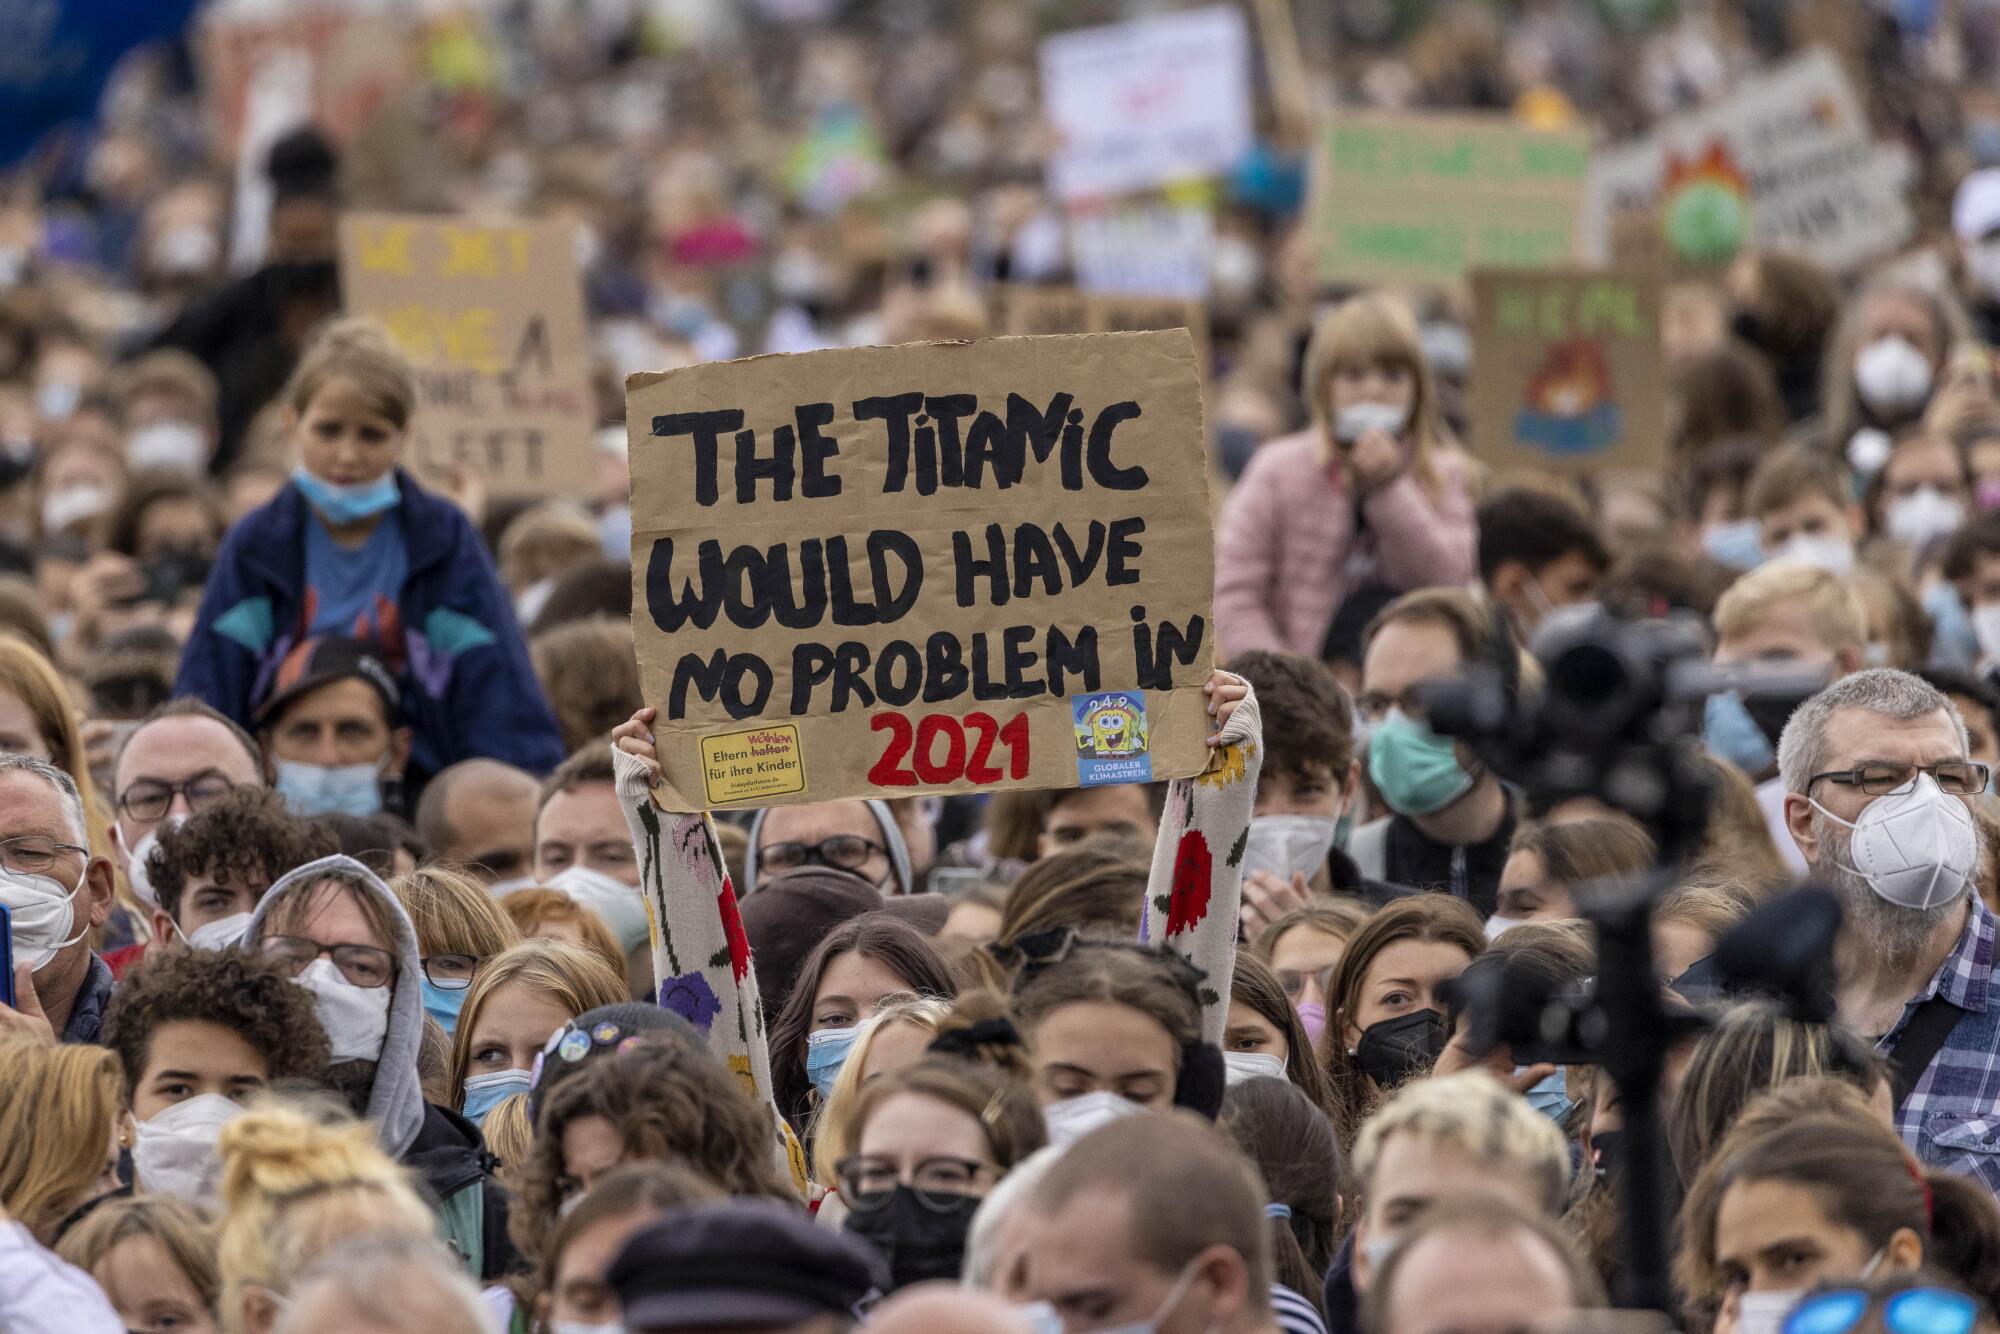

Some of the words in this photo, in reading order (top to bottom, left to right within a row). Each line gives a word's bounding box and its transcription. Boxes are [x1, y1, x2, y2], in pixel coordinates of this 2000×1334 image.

[651, 403, 841, 506] THE
[646, 530, 924, 633] WOULD
[952, 517, 1145, 608] HAVE
[668, 648, 773, 720] NO
[790, 624, 1101, 715] PROBLEM
[709, 768, 726, 780] für
[730, 765, 753, 777] ihre
[757, 758, 797, 773] Kinder
[713, 750, 748, 763] Eltern
[868, 712, 1030, 785] 2021
[1094, 761, 1141, 772] GLOBALER
[1088, 769, 1147, 781] KLIMASTREIK
